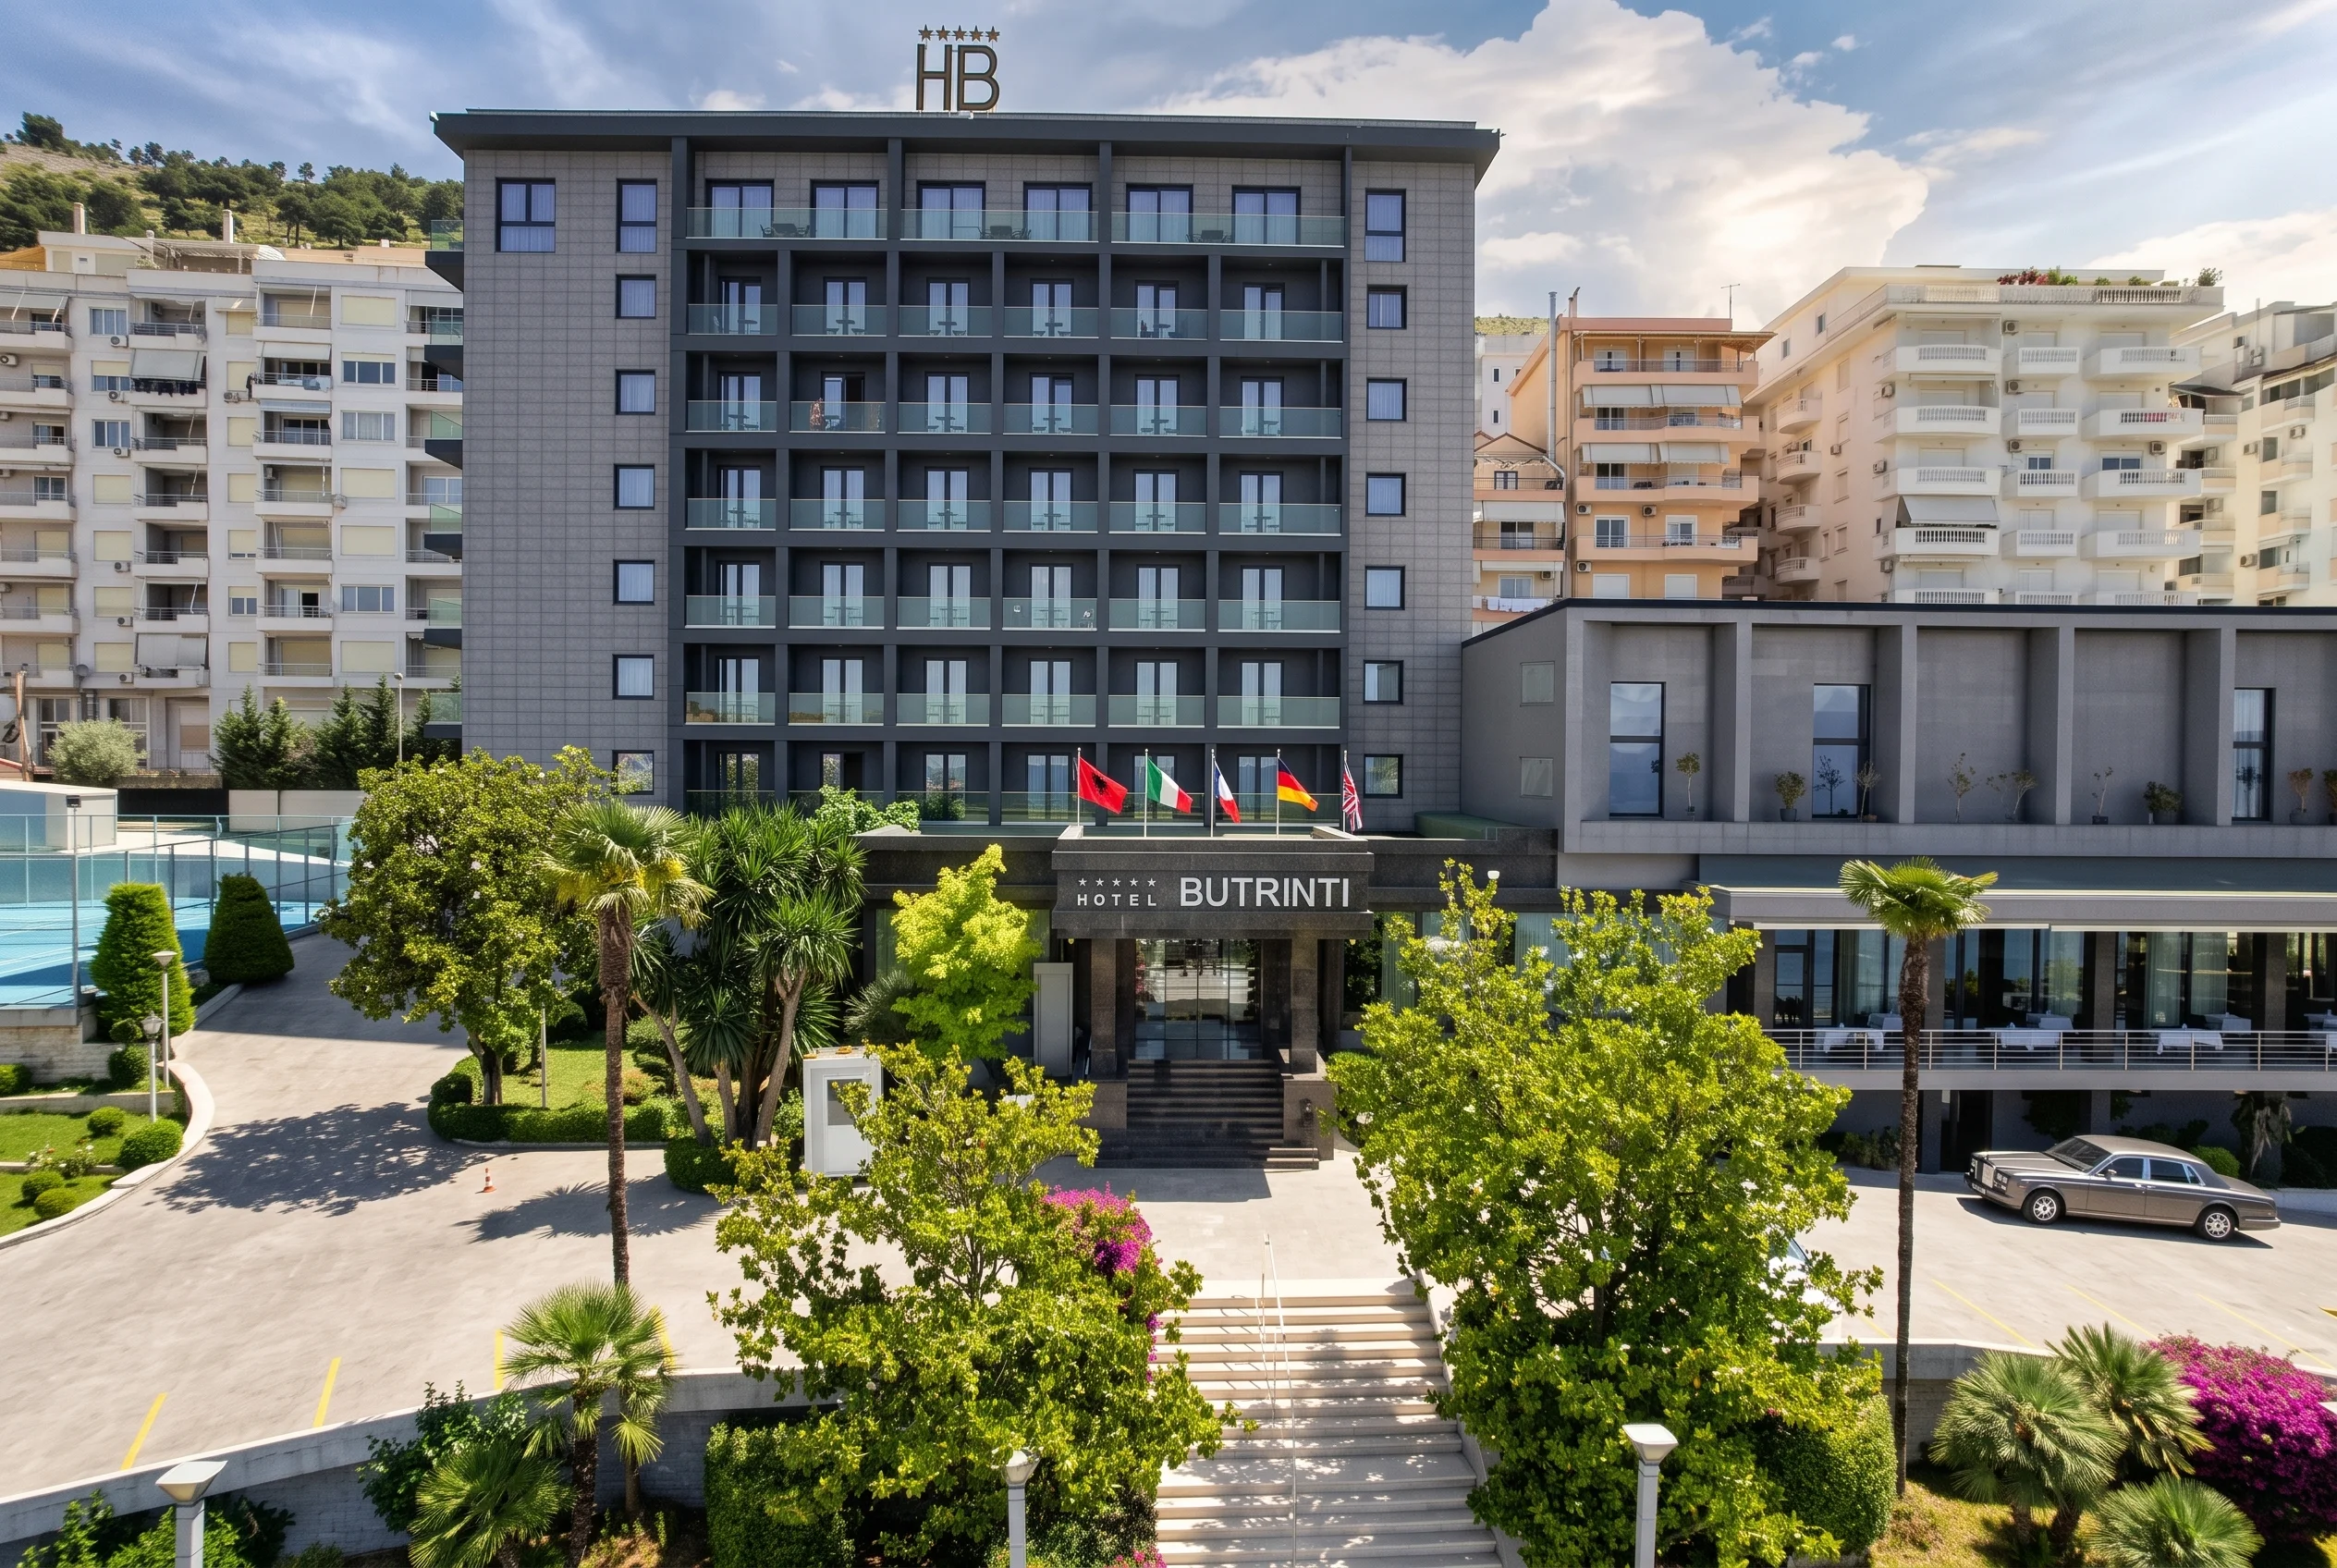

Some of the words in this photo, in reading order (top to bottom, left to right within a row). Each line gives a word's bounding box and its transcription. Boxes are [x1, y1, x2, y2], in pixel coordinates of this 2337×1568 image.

[916, 43, 1000, 111] HB
[1077, 894, 1156, 906] HOTEL
[1180, 876, 1349, 907] BUTRINTI
